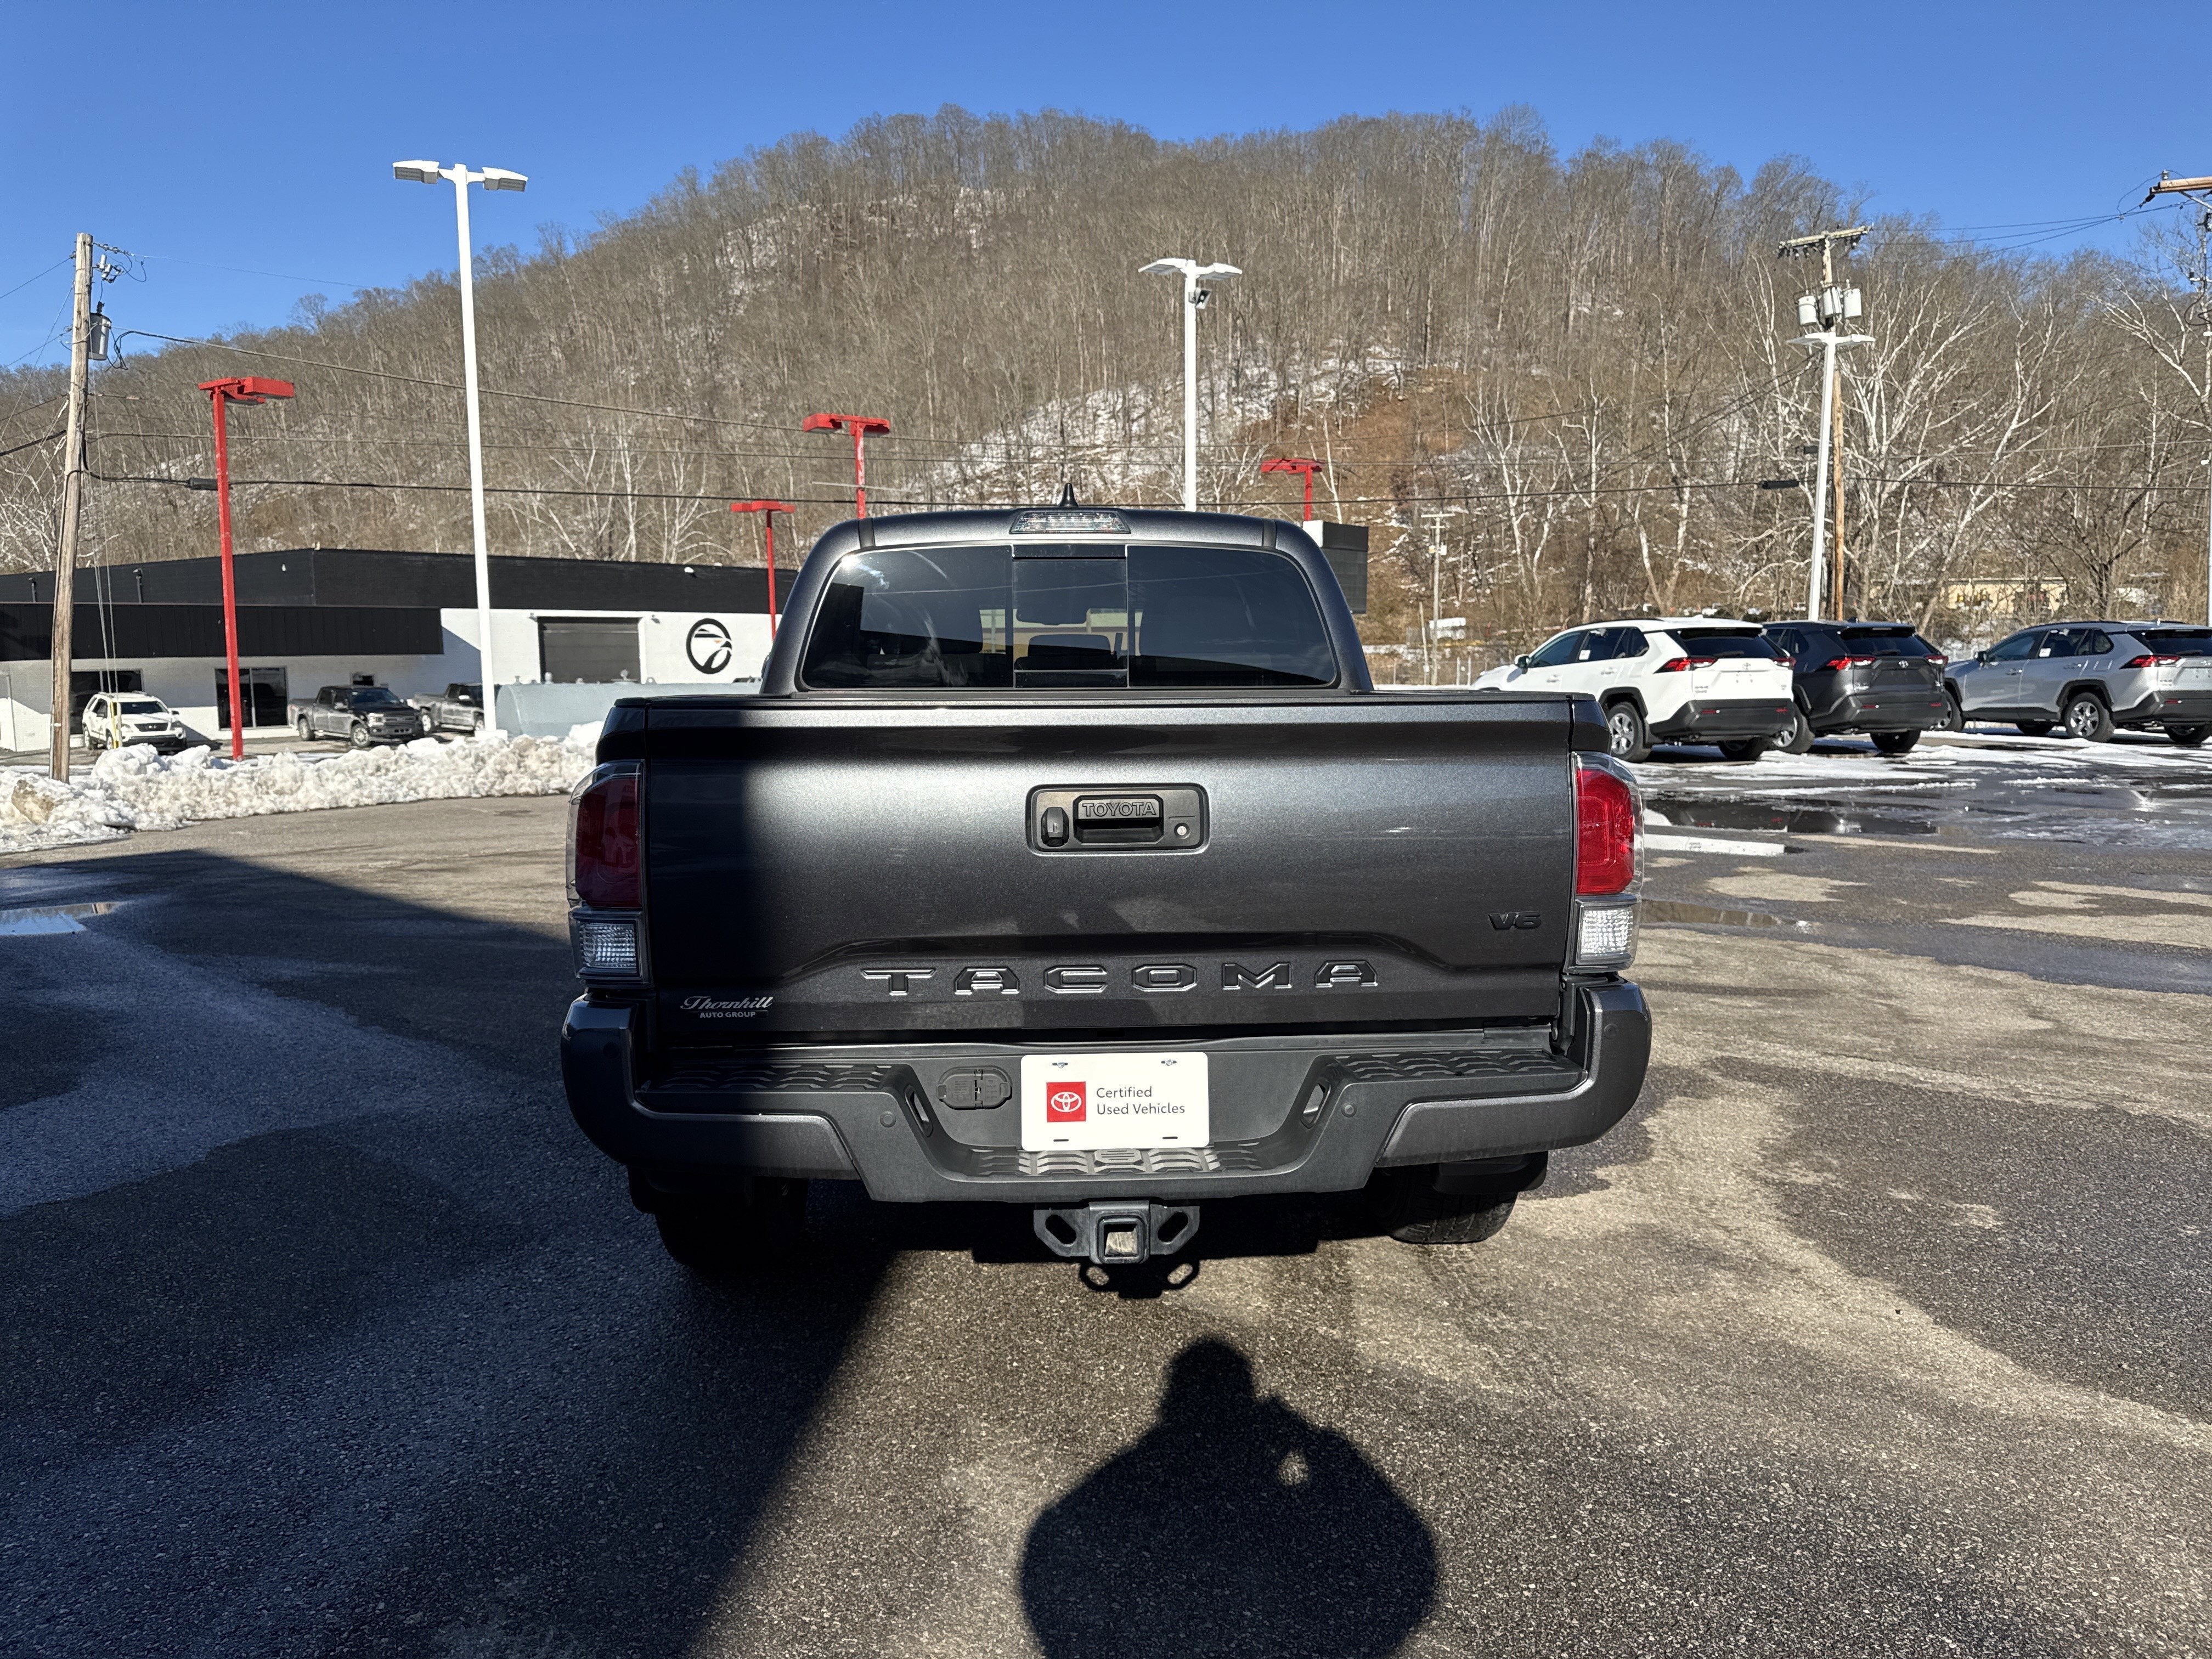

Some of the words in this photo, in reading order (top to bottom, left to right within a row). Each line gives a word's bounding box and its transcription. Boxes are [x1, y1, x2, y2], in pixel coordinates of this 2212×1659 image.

[1082, 801, 1156, 817] TOYOTA
[1488, 911, 1542, 930] V6
[860, 960, 1378, 996] TACOMA
[680, 996, 774, 1009] Thornhill
[1096, 1086, 1153, 1098] Certified
[1097, 1103, 1129, 1115] Used
[1132, 1102, 1186, 1114] Vehicles
